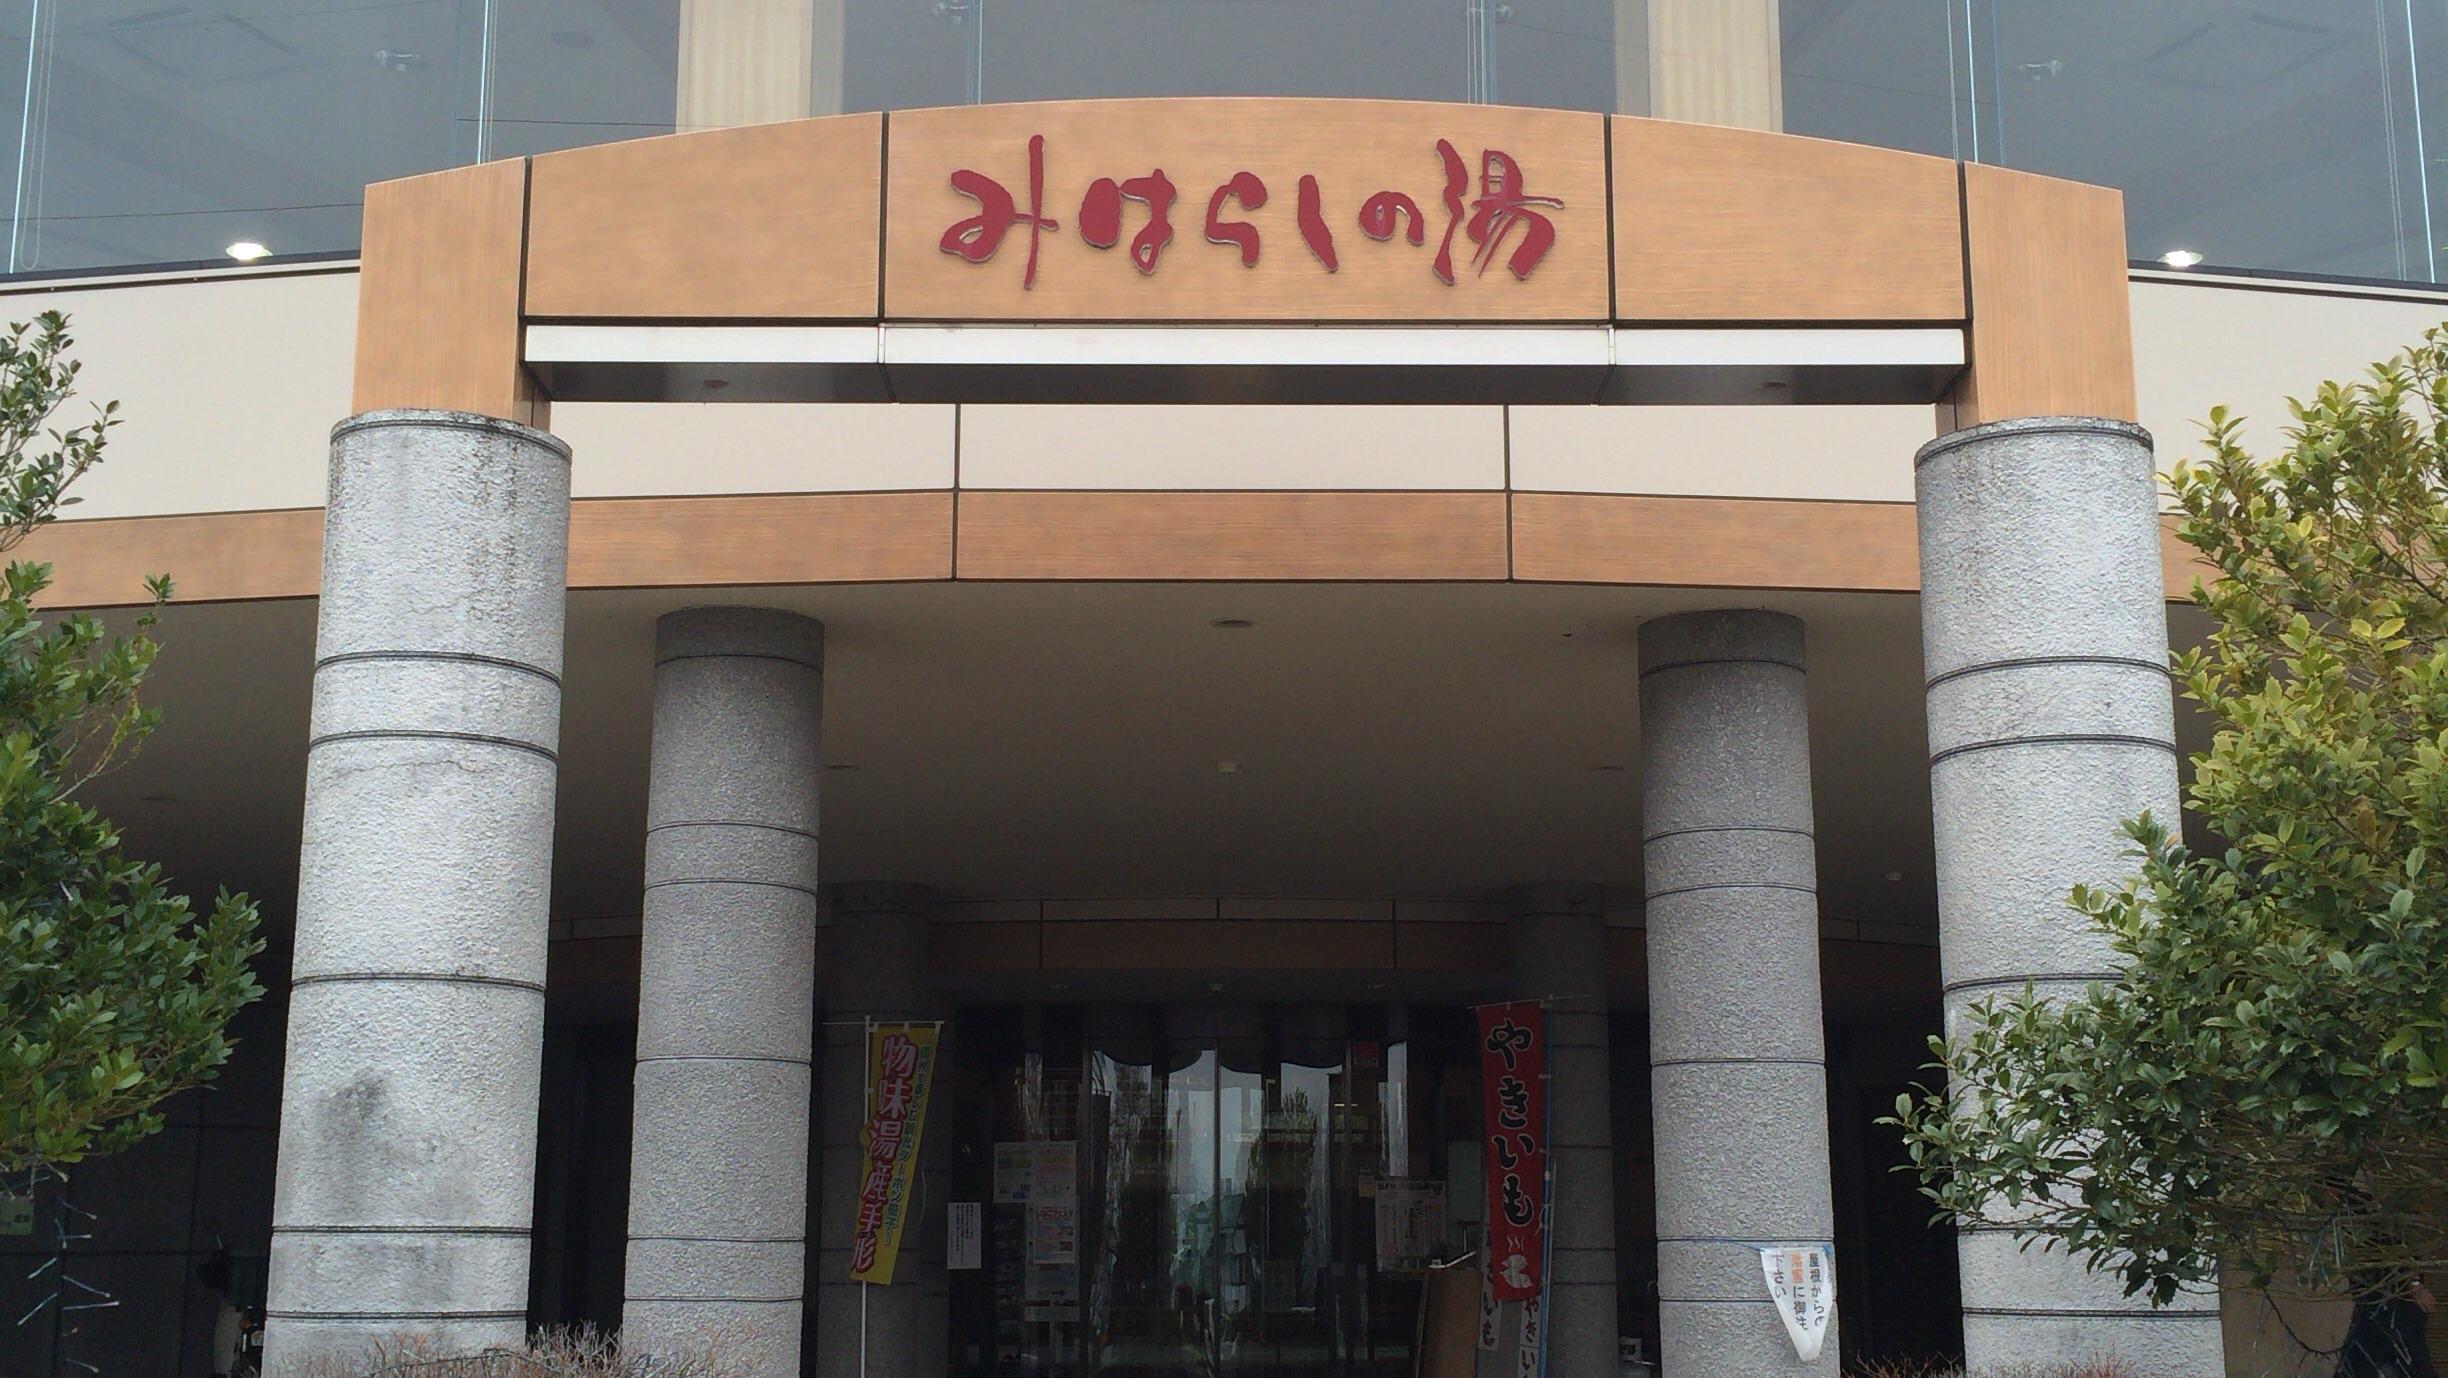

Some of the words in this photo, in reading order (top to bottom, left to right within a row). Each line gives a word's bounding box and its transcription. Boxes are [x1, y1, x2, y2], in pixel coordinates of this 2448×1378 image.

[939, 134, 1566, 292] みはらしの湯
[852, 1034, 917, 1272] 物味湯産手形
[1486, 1017, 1535, 1226] やきいも
[1522, 1297, 1539, 1378] やきい
[1771, 1254, 1787, 1298] 下さい
